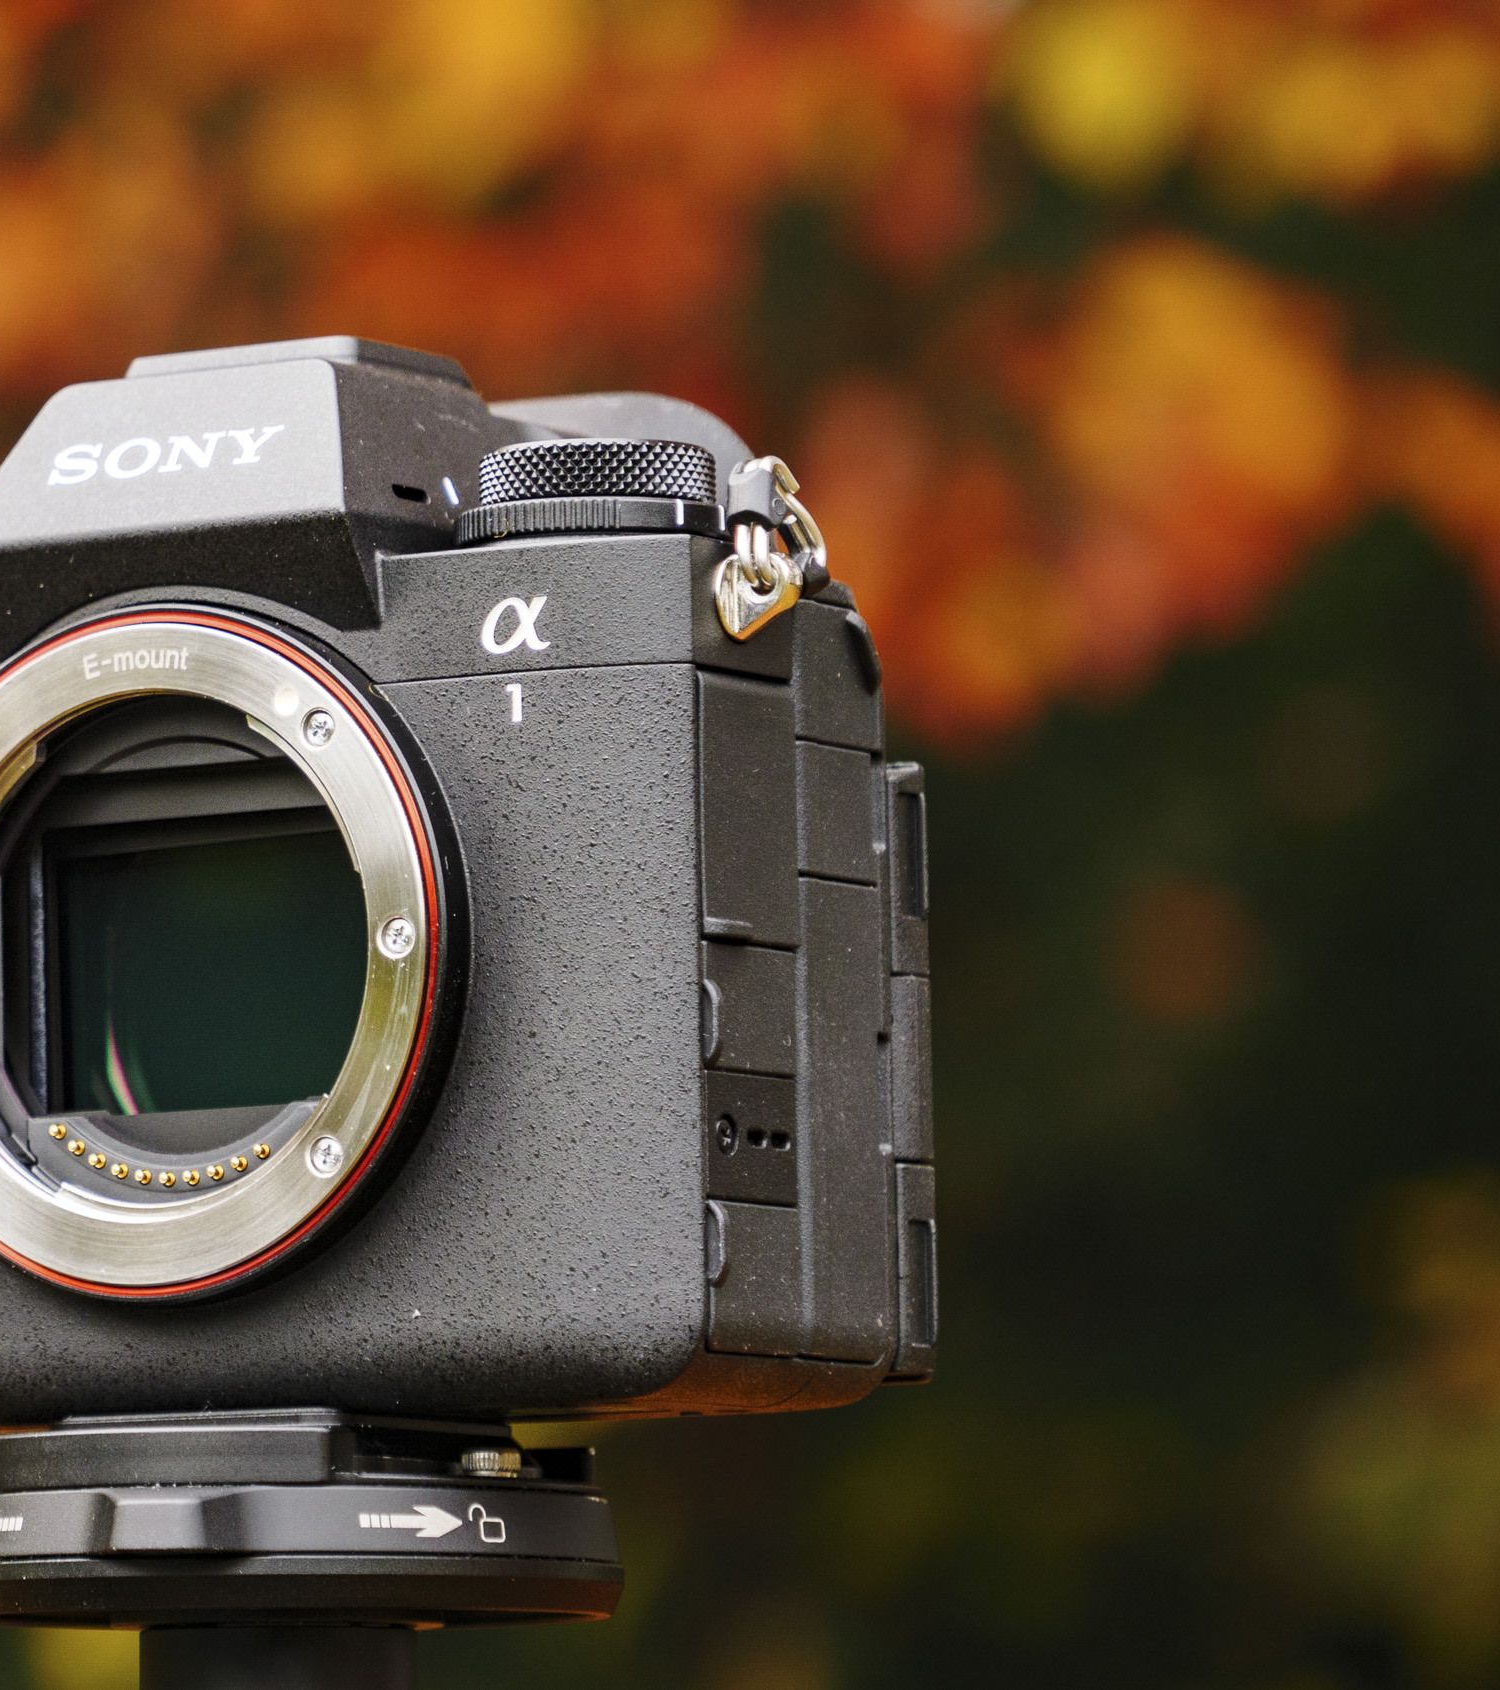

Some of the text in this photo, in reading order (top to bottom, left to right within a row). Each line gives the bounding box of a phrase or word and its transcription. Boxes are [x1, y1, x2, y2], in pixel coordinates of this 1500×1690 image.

[47, 424, 284, 486] SONY
[83, 646, 189, 680] E-mount
[505, 683, 524, 723] 1
